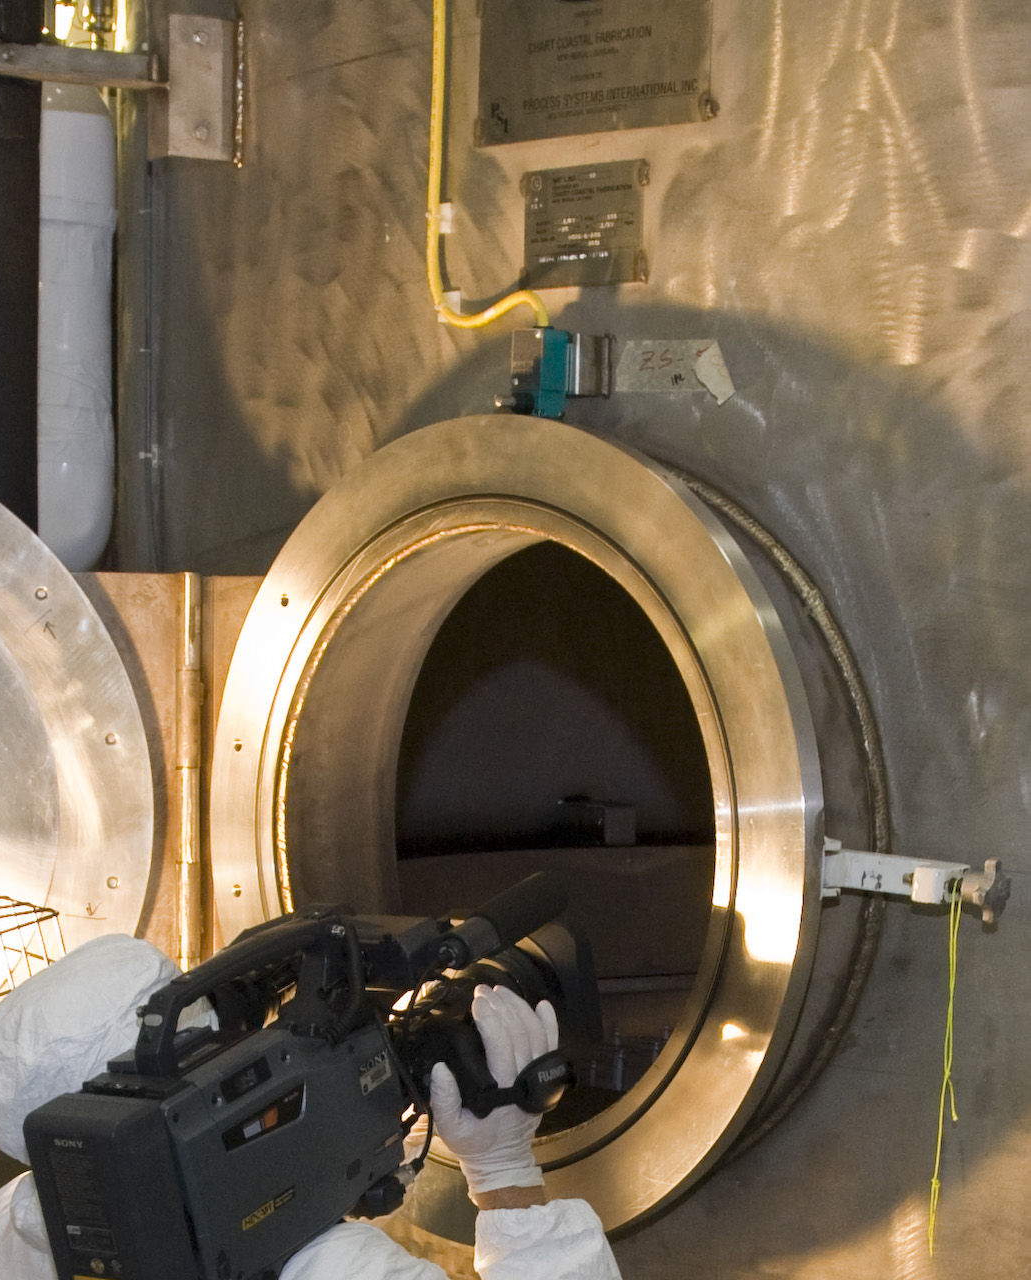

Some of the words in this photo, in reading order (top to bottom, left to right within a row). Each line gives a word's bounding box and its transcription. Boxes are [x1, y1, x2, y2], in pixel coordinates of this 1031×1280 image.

[596, 25, 652, 45] FABRICATION
[523, 94, 561, 110] PROCESS
[564, 89, 604, 107] SYSTEMS
[607, 82, 678, 101] INTERNATIONAL
[53, 1138, 83, 1149] SONY
